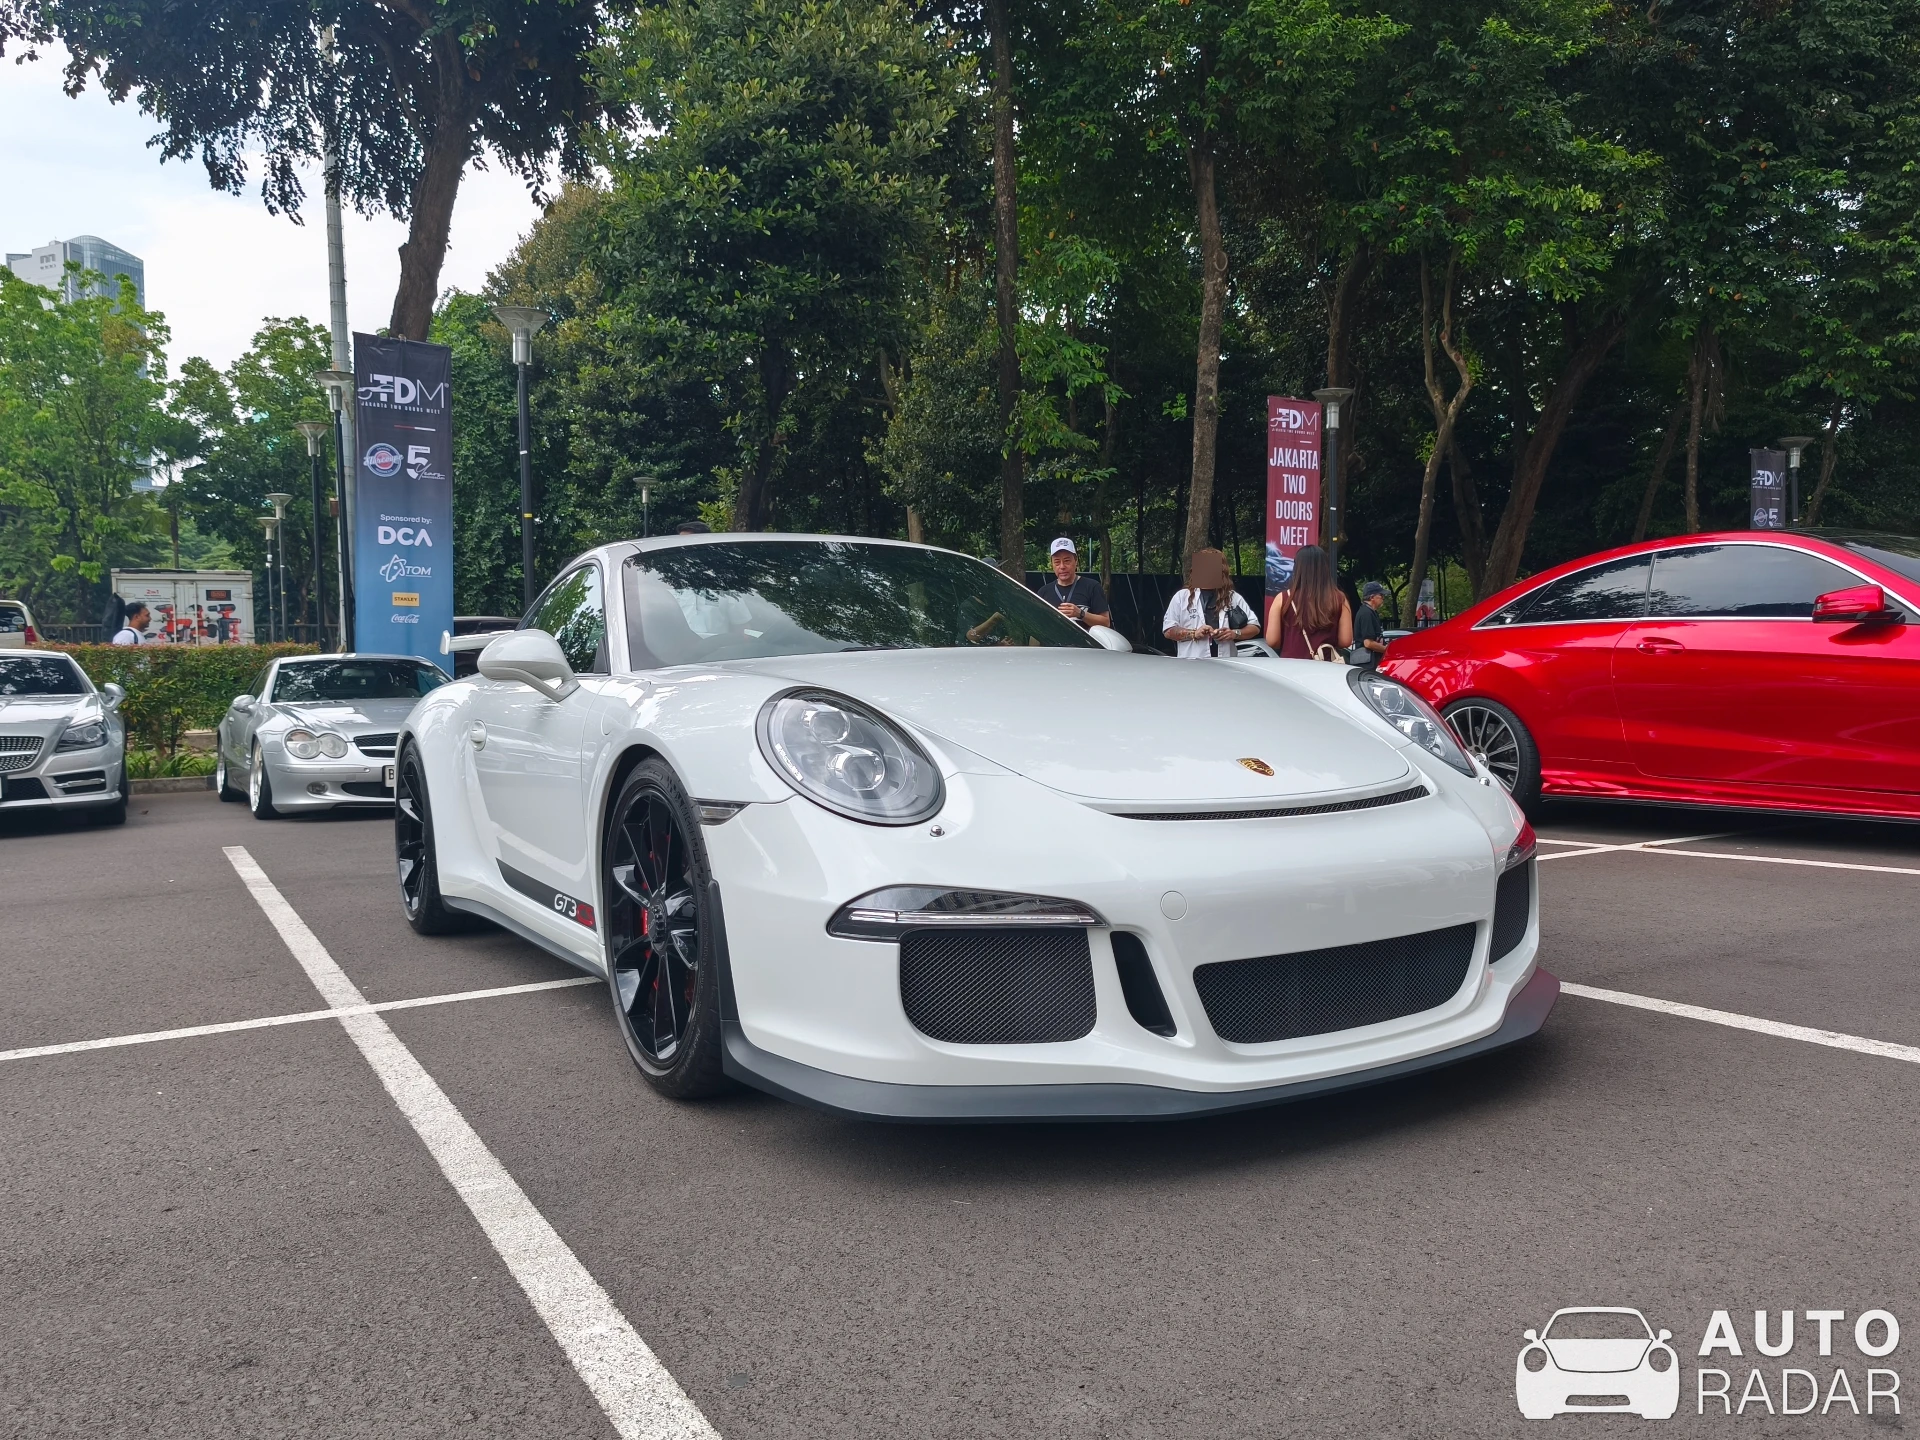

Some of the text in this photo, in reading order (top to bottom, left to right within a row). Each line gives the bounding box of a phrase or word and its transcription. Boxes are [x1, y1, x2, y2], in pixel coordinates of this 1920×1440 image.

[407, 444, 431, 479] 5
[1270, 447, 1319, 470] JAKARTA
[1282, 474, 1307, 495] TWO
[380, 514, 433, 525] Sponsored by:
[1275, 500, 1313, 521] DOORS
[377, 525, 433, 547] DCA
[1280, 526, 1309, 546] MEET
[388, 768, 395, 780] B
[554, 893, 577, 917] GT3
